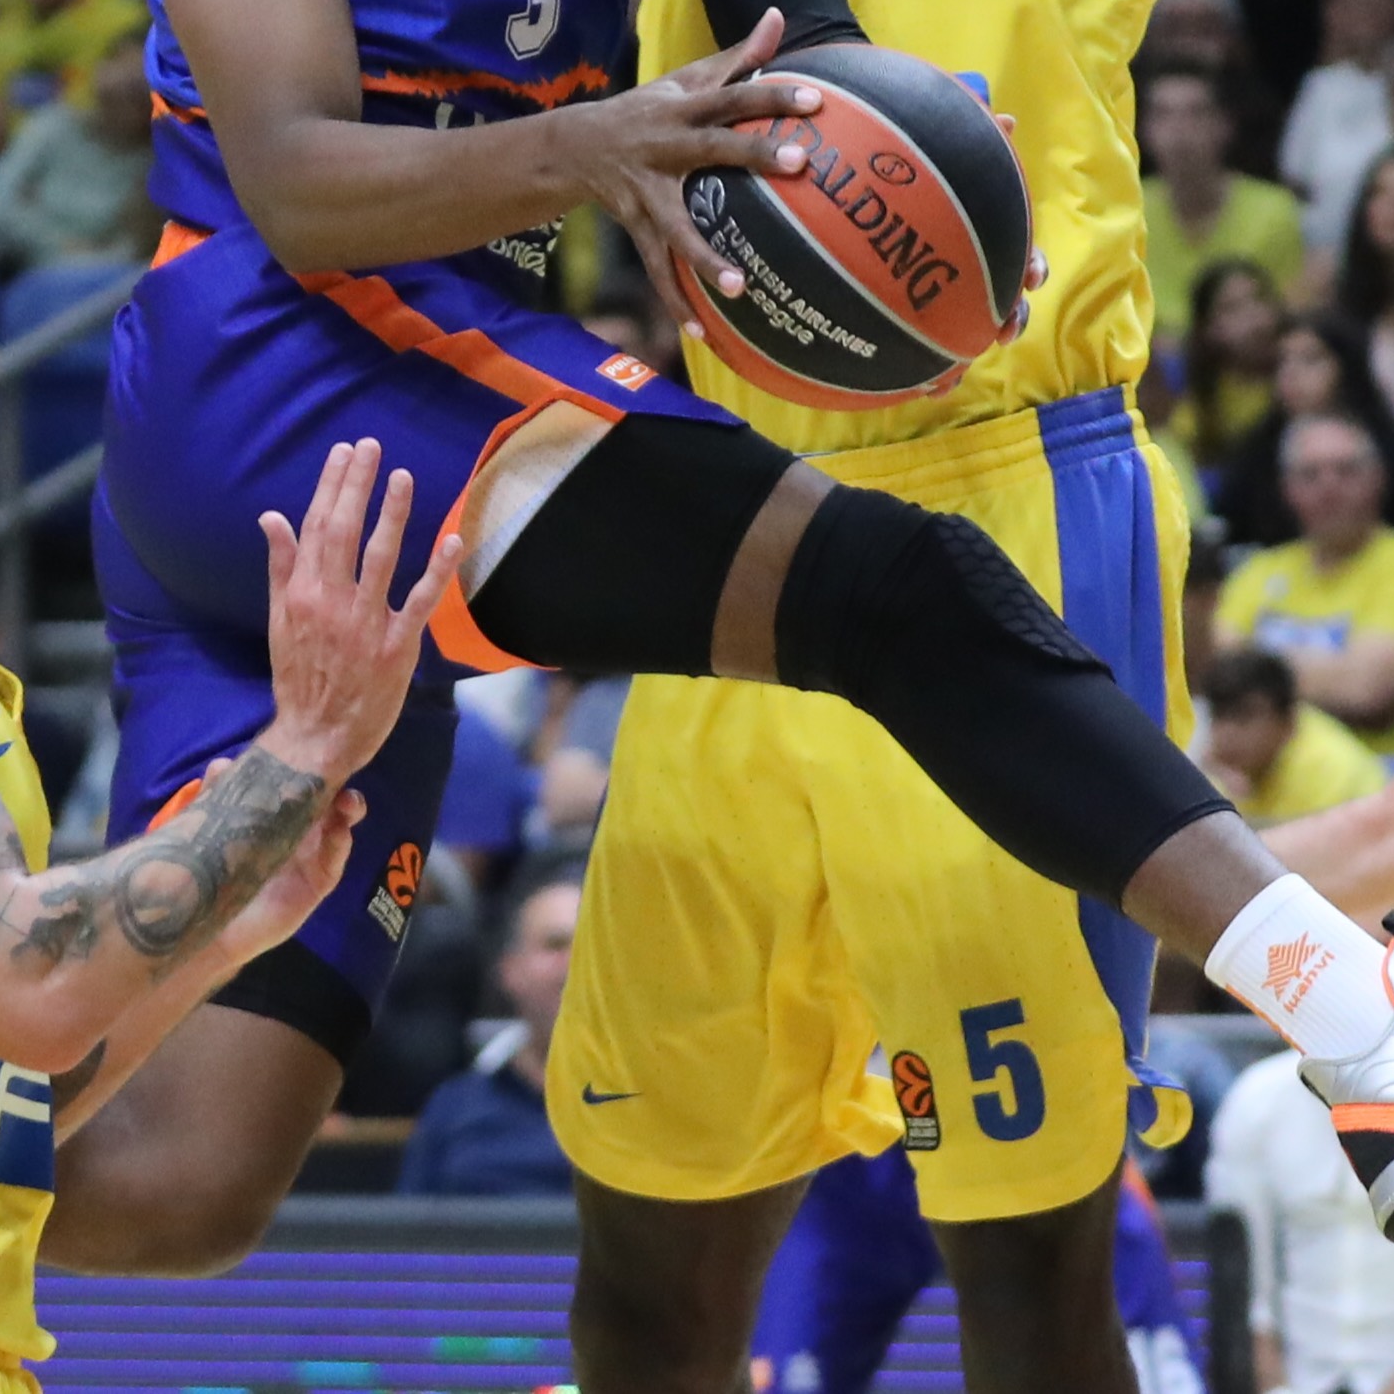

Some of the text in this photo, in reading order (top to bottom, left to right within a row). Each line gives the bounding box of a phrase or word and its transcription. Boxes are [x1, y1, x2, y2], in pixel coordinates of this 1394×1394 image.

[722, 216, 878, 358] TURKISH AIRLINES
[960, 998, 1045, 1142] 5
